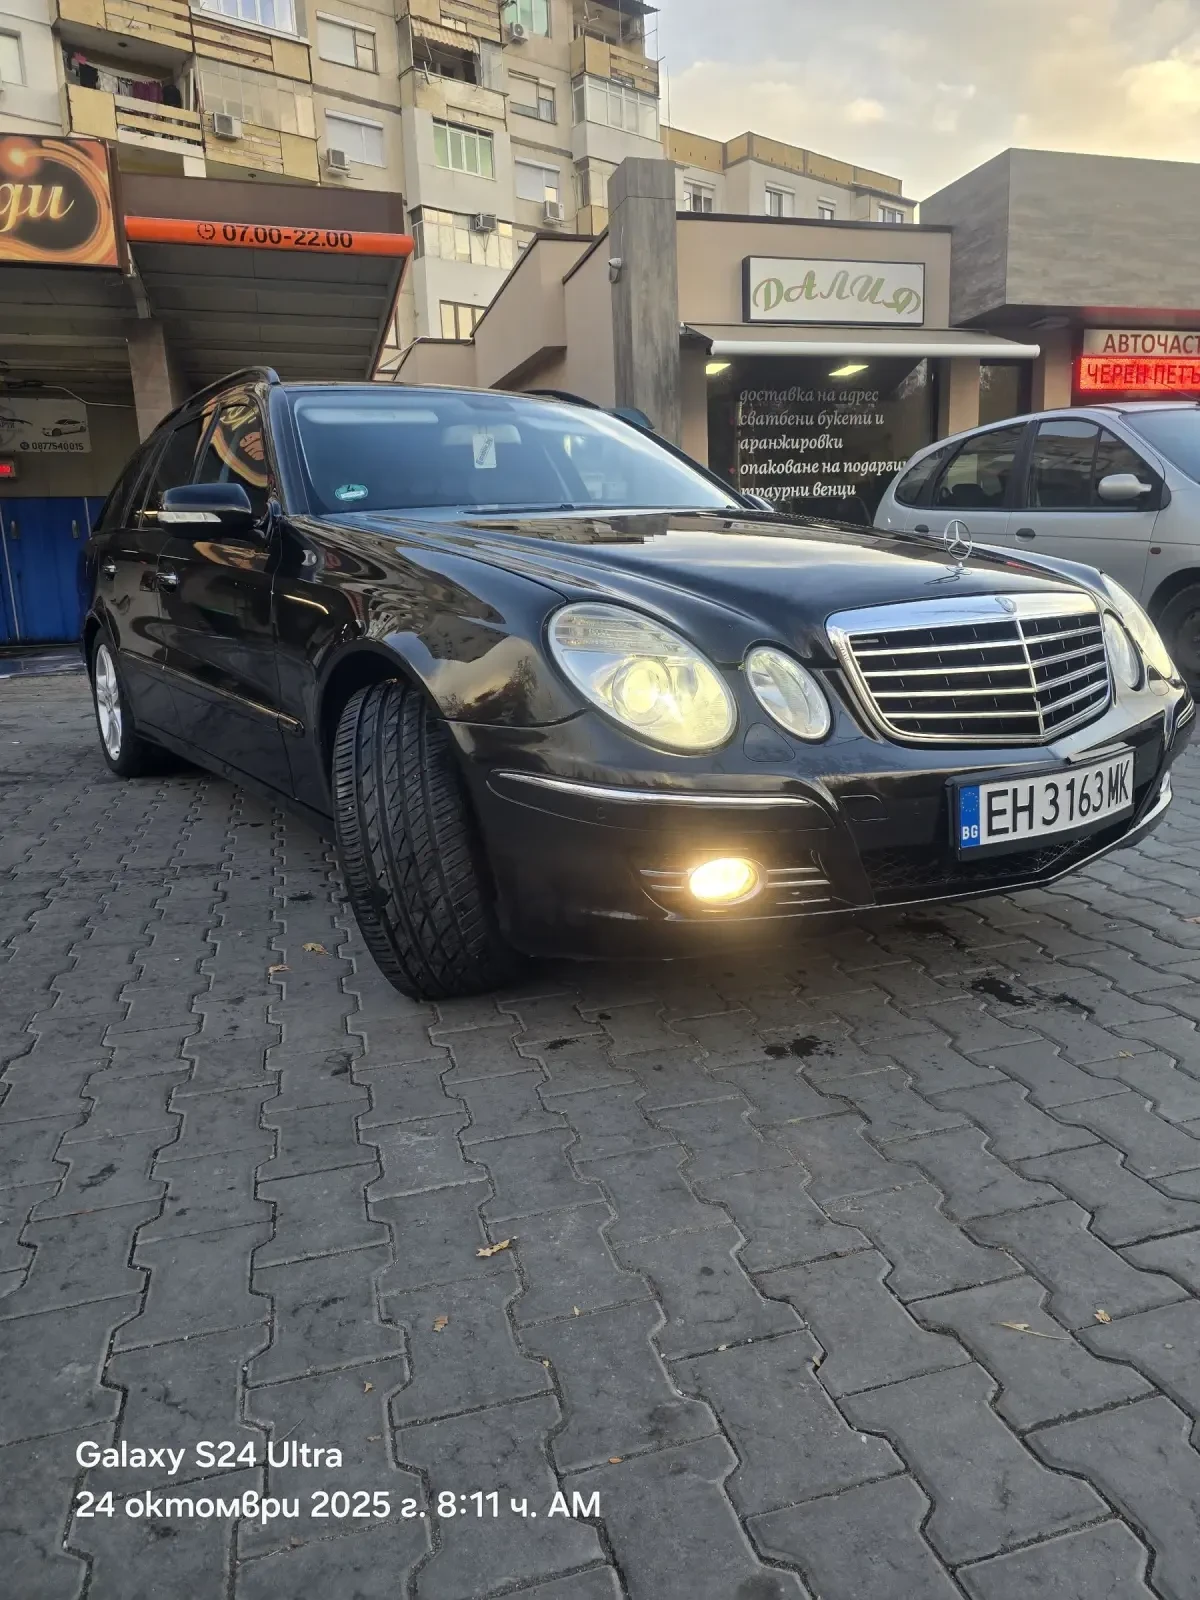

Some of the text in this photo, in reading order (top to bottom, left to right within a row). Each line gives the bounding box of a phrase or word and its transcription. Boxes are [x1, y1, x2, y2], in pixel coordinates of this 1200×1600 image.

[222, 223, 354, 249] 07.00-22.00
[752, 269, 922, 315] ДАЛИЯ
[1087, 363, 1147, 385] ЧЕРЕН
[739, 386, 879, 405] доставка на адрес
[739, 410, 885, 428] сватбени букети и
[740, 434, 844, 454] аранжировки
[740, 459, 819, 475] опаковане
[822, 461, 841, 474] на
[812, 481, 857, 500] венци
[962, 825, 979, 841] BG
